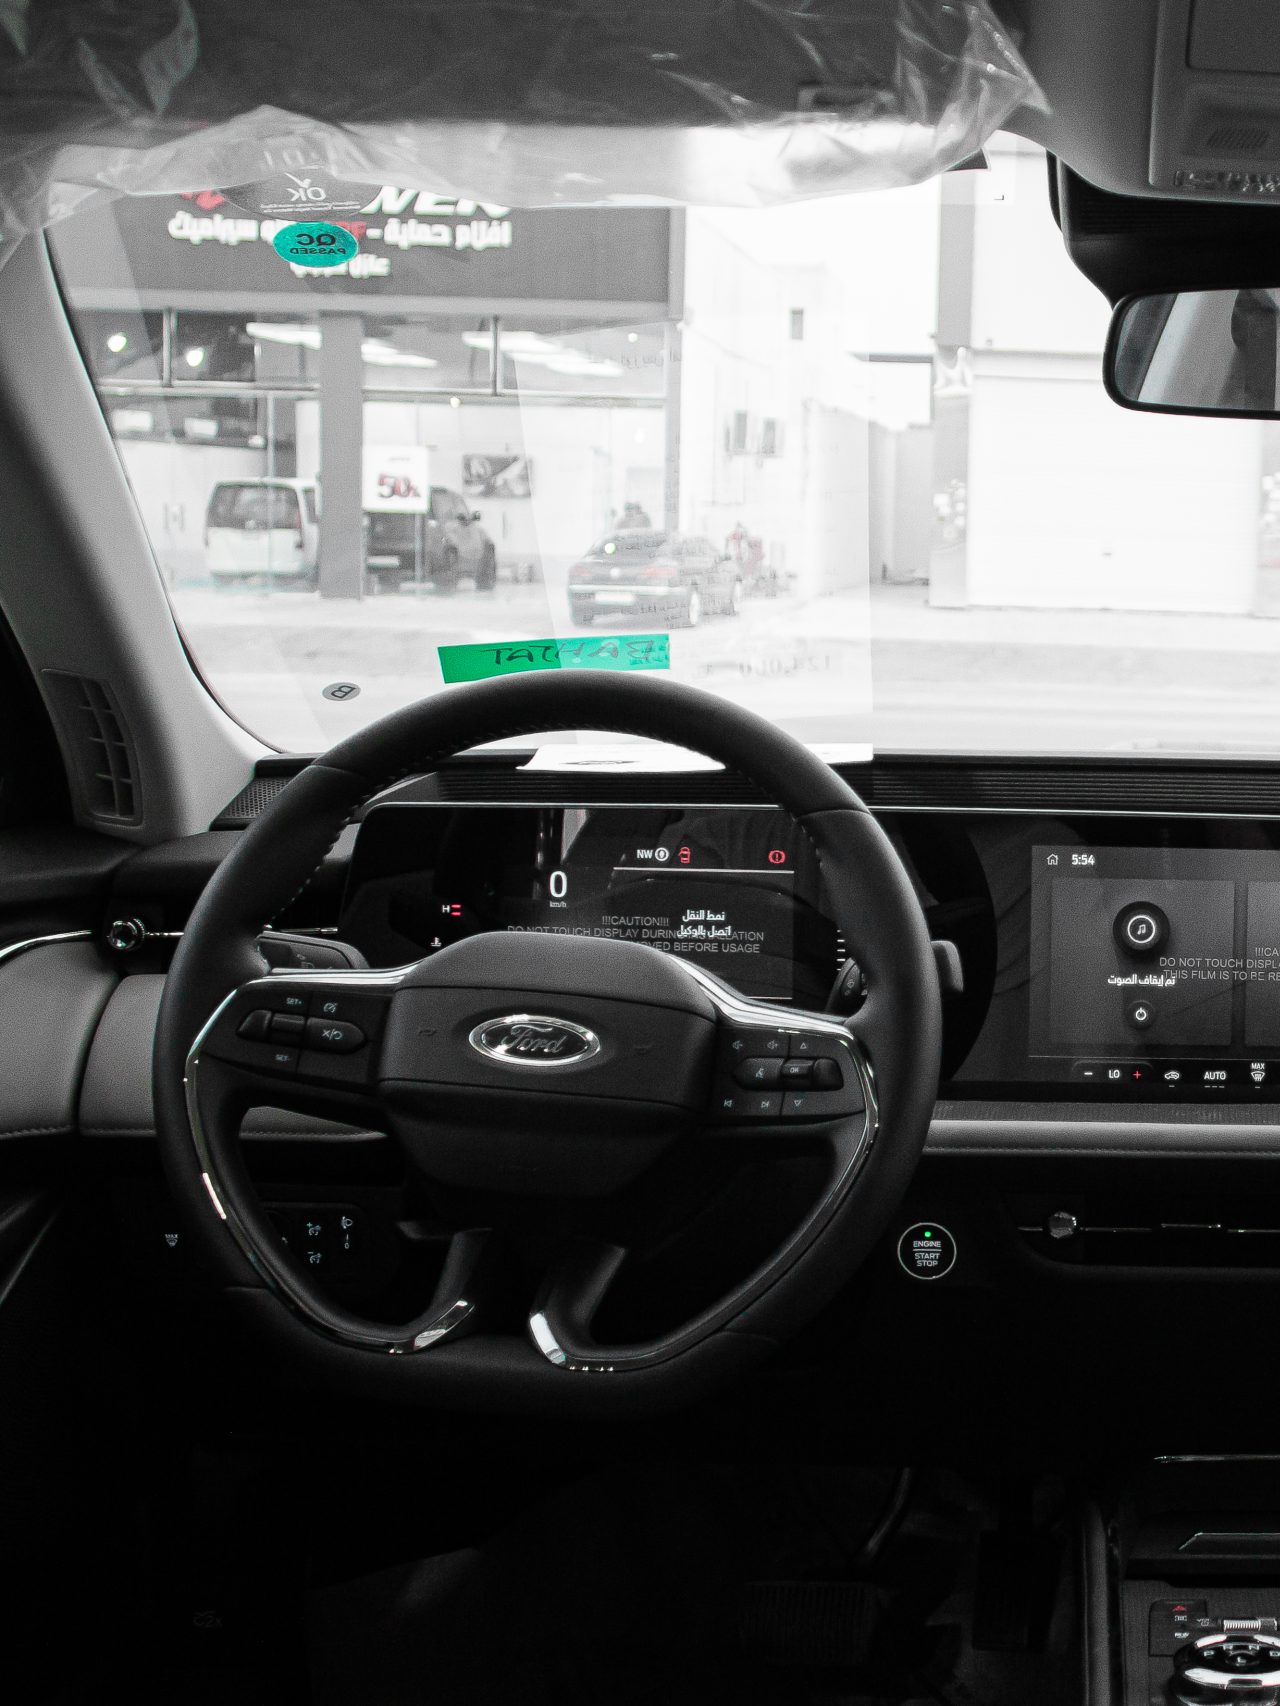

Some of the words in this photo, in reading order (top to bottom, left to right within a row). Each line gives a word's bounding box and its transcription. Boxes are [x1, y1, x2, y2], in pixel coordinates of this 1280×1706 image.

[637, 849, 652, 859] NW
[1071, 854, 1095, 865] 5:54
[550, 871, 567, 898] 0
[682, 909, 705, 922] النقل
[594, 928, 639, 938] DISPLAY
[674, 942, 719, 952] BEFORE
[722, 944, 760, 953] USAGE
[1159, 957, 1176, 967] DO
[1179, 957, 1201, 967] NOT
[1205, 958, 1243, 968] TOUCH
[1107, 973, 1138, 987] الصوت
[1191, 970, 1216, 980] FILM
[1219, 971, 1230, 980] IS
[1233, 971, 1248, 980] TO
[1251, 972, 1265, 981] BE
[501, 1024, 568, 1053] Ford
[1251, 1062, 1265, 1070] MAX
[1108, 1069, 1121, 1079] LO
[1203, 1071, 1227, 1080] AUTO
[913, 1240, 941, 1248] ENGINE
[914, 1252, 940, 1260] START
